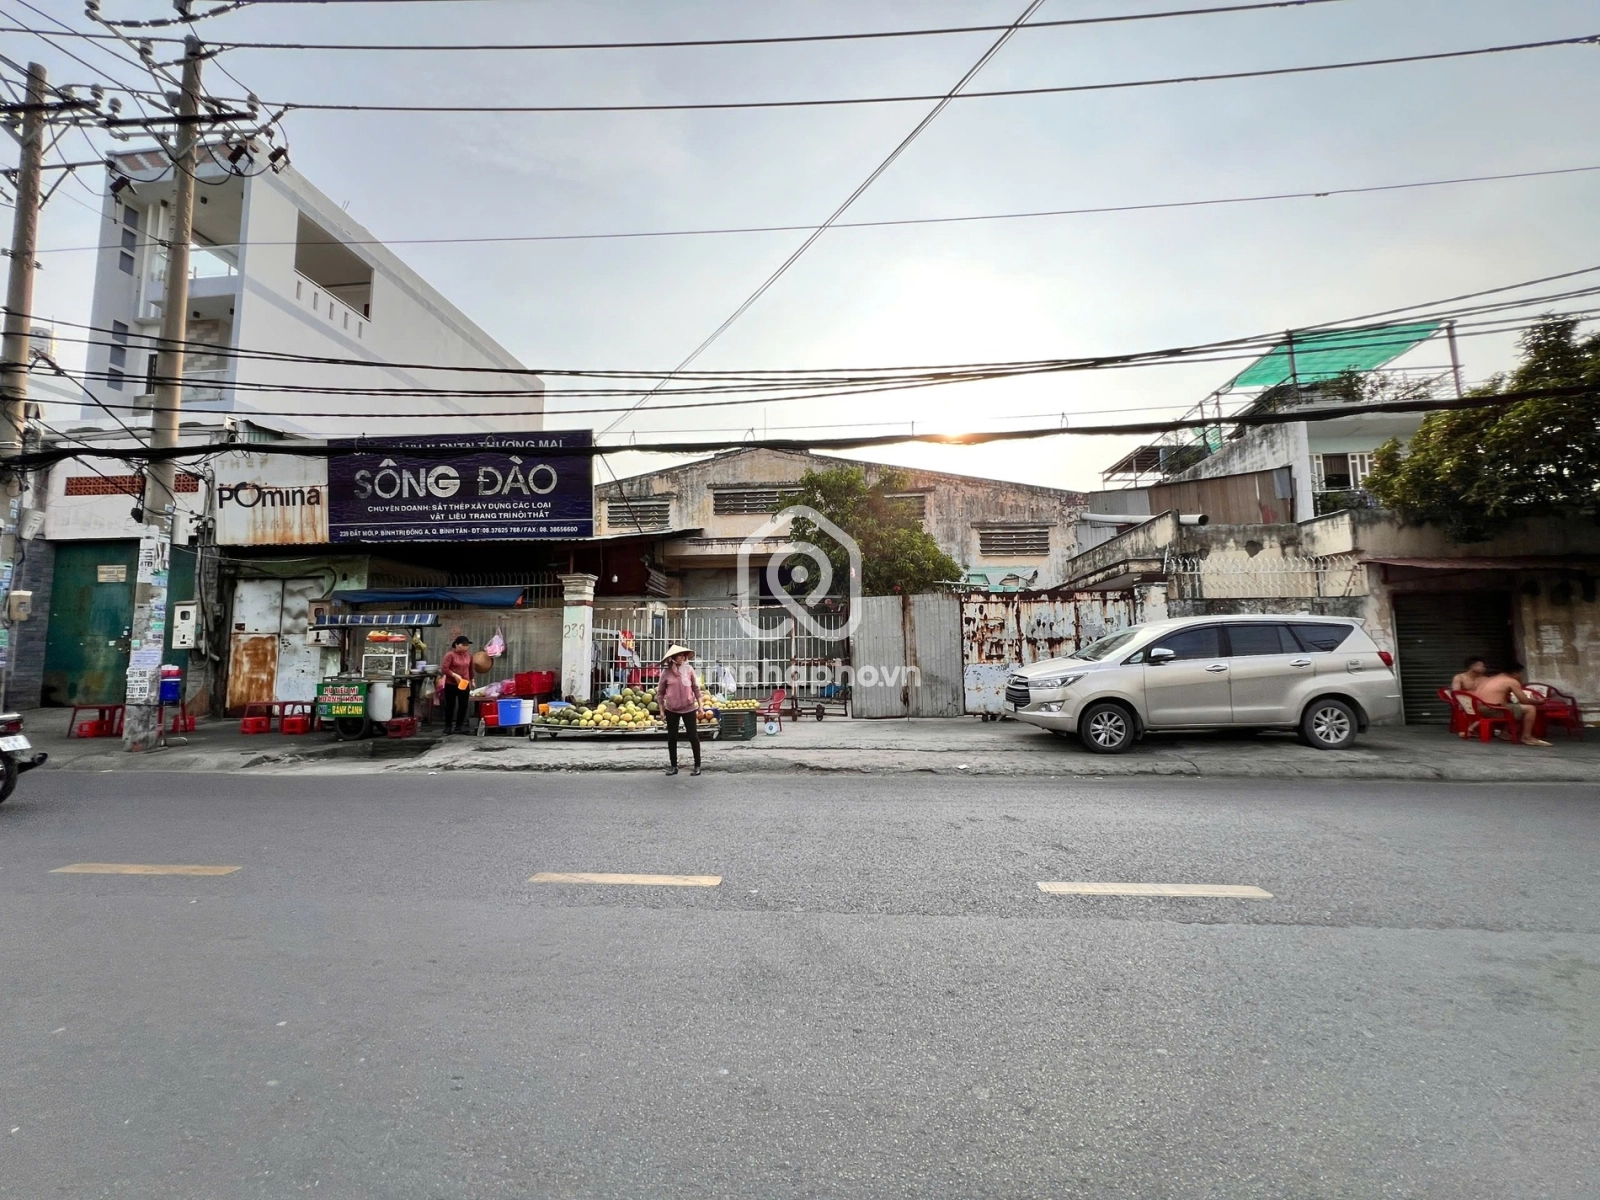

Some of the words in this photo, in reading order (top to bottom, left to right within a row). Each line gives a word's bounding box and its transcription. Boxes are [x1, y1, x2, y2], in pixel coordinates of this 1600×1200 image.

[354, 458, 461, 499] SÔNG
[476, 455, 558, 497] ĐÀO
[512, 501, 530, 509] CÁC
[469, 512, 497, 520] TRANG
